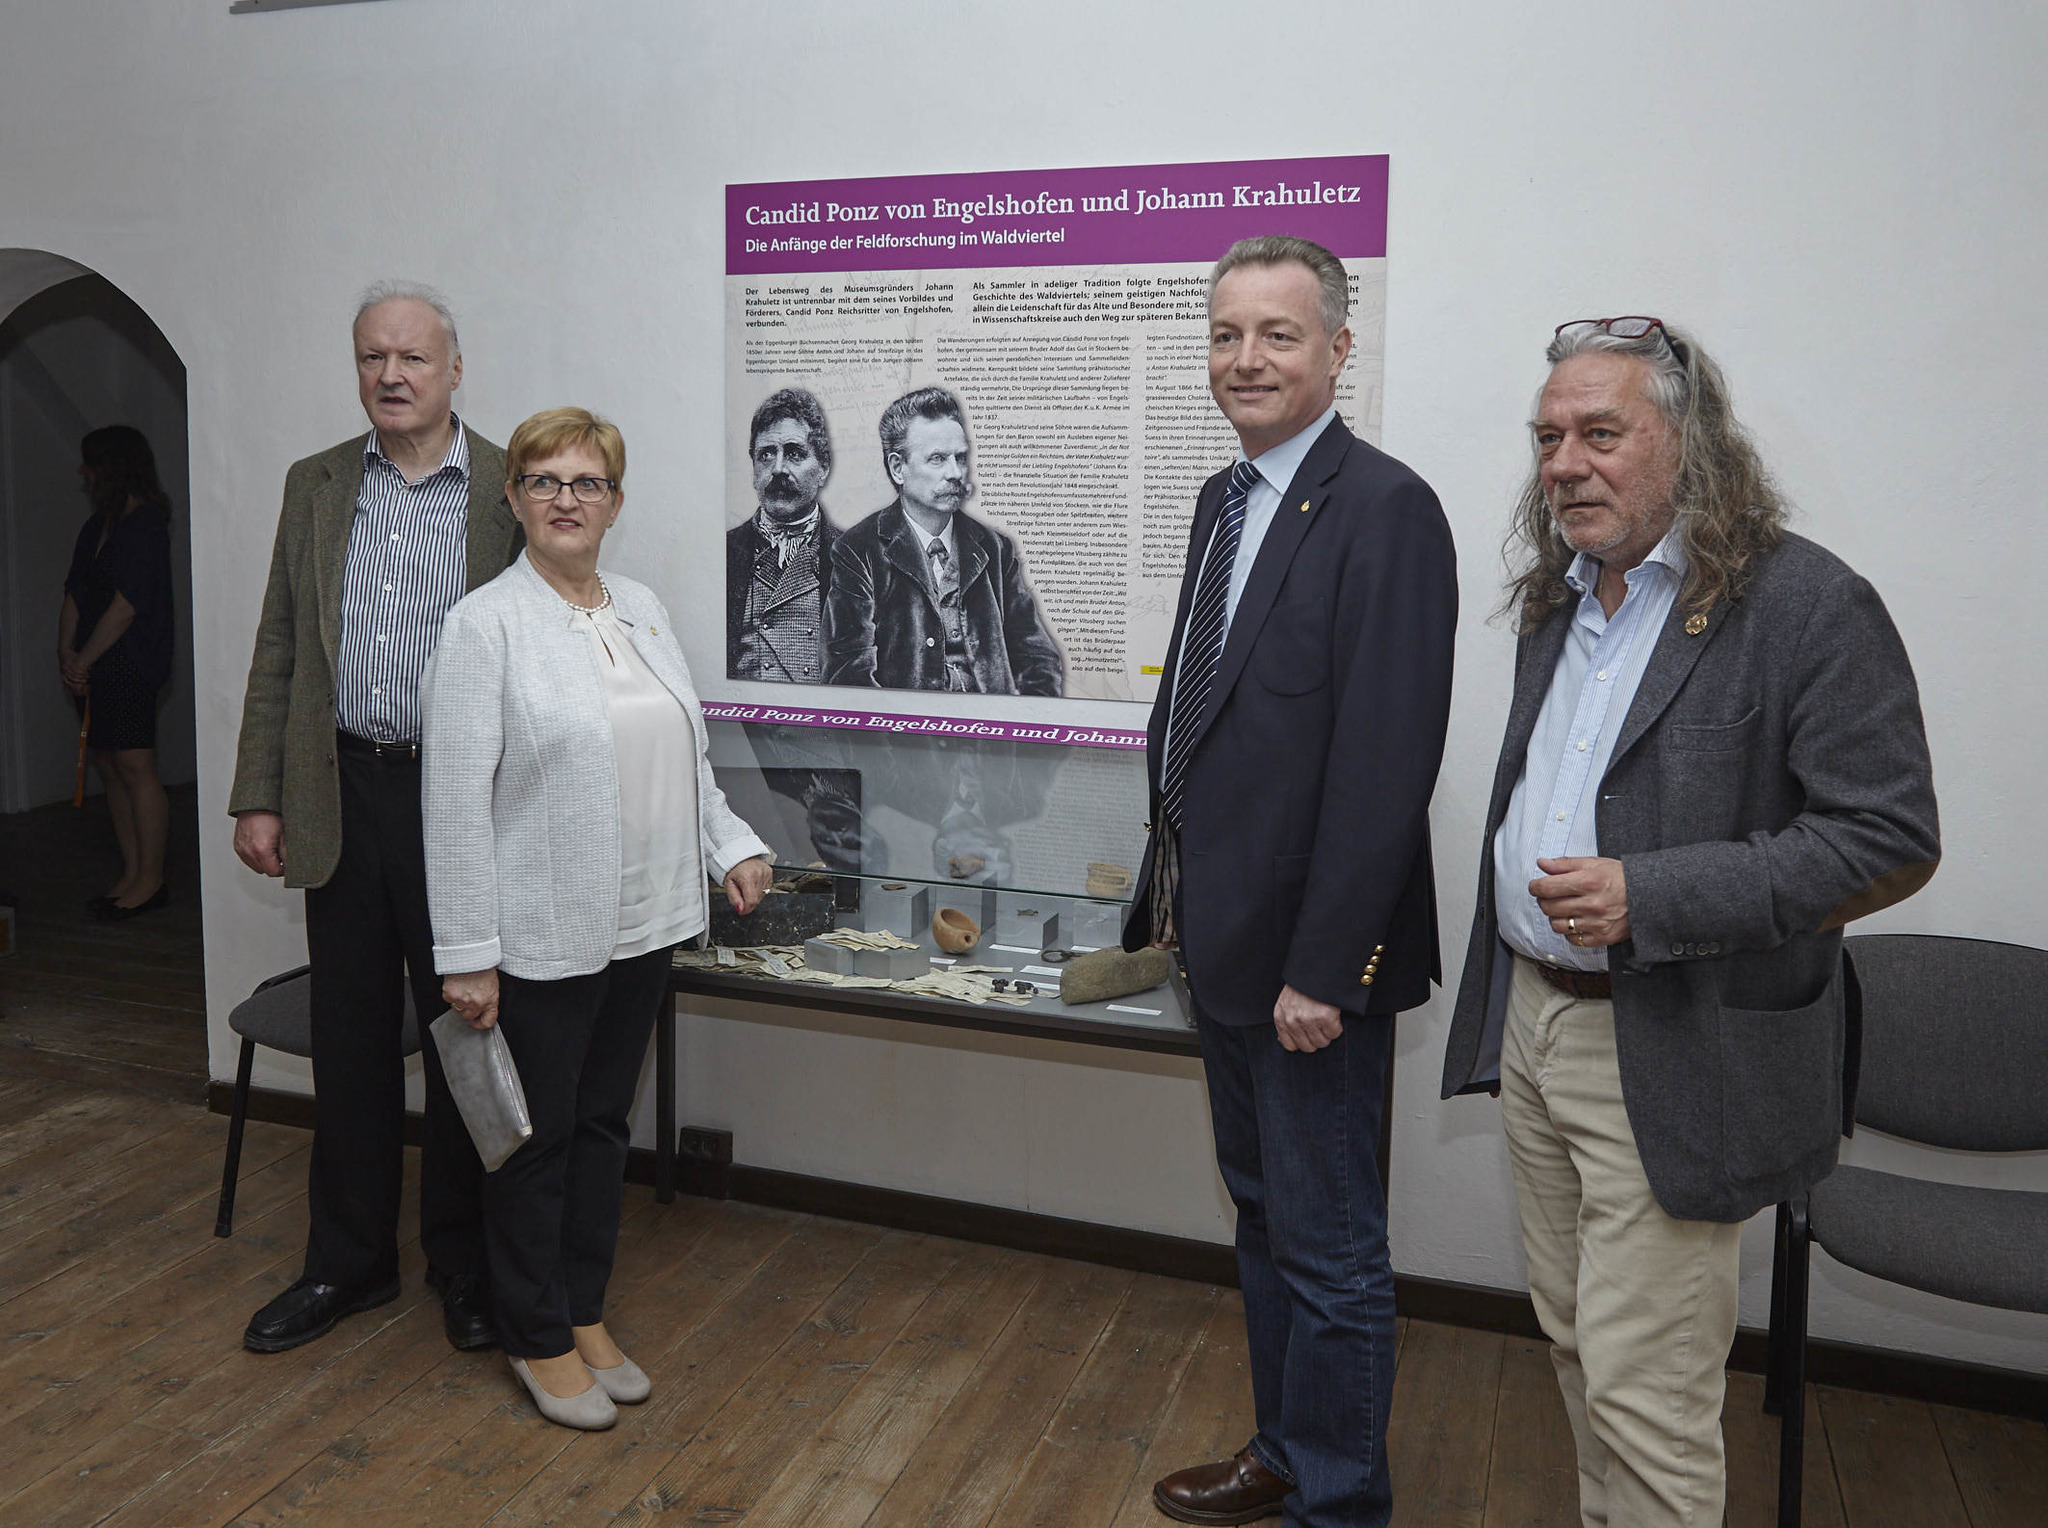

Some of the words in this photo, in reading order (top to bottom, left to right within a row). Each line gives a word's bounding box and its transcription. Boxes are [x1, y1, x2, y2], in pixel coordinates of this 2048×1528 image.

[745, 202, 820, 225] Candid
[826, 203, 879, 221] Ponz
[884, 204, 926, 218] von
[933, 192, 1075, 224] Engelshofen
[1081, 190, 1129, 212] und
[1135, 188, 1225, 214] Johann
[1232, 182, 1360, 206] Krahuletz
[746, 239, 767, 252] Die
[770, 236, 827, 254] Anfänge
[830, 236, 854, 250] der
[856, 232, 956, 251] Feldforschung
[959, 232, 978, 246] im
[981, 228, 1064, 244] Waldviertel
[769, 287, 809, 296] Lebensweg
[844, 284, 914, 294] Museumsgründers
[925, 283, 954, 291] Johann
[1044, 280, 1078, 290] adeliger
[1084, 279, 1121, 287] Tradition
[1127, 279, 1151, 289] folgte
[794, 297, 835, 305] untrennbar
[853, 296, 870, 304] dem
[938, 294, 954, 302] und
[973, 293, 1016, 301] Geschichte
[1019, 292, 1033, 300] des
[1037, 292, 1090, 300] Waldviertels;
[1127, 290, 1165, 300] geistigen
[1169, 289, 1207, 299] Nachfolg
[746, 309, 781, 317] Förderers,
[786, 308, 811, 316] Candid
[838, 307, 880, 315] Reichsritter
[904, 306, 954, 316] Engelshofen,
[1010, 303, 1061, 311] Leidenschaft
[1093, 302, 1110, 310] Alte
[1176, 301, 1192, 309] mit,
[981, 315, 1061, 323] Wissenschaftskreise
[1063, 314, 1083, 322] auch
[1084, 314, 1100, 322] den
[1101, 314, 1119, 323] Weg
[1137, 314, 1173, 322] späteren
[701, 707, 758, 719] ndid
[761, 710, 815, 722] Ponz
[821, 716, 860, 726] von
[866, 717, 1004, 736] Engelshofen
[1012, 728, 1058, 740] und
[1061, 730, 1148, 746] Johann
